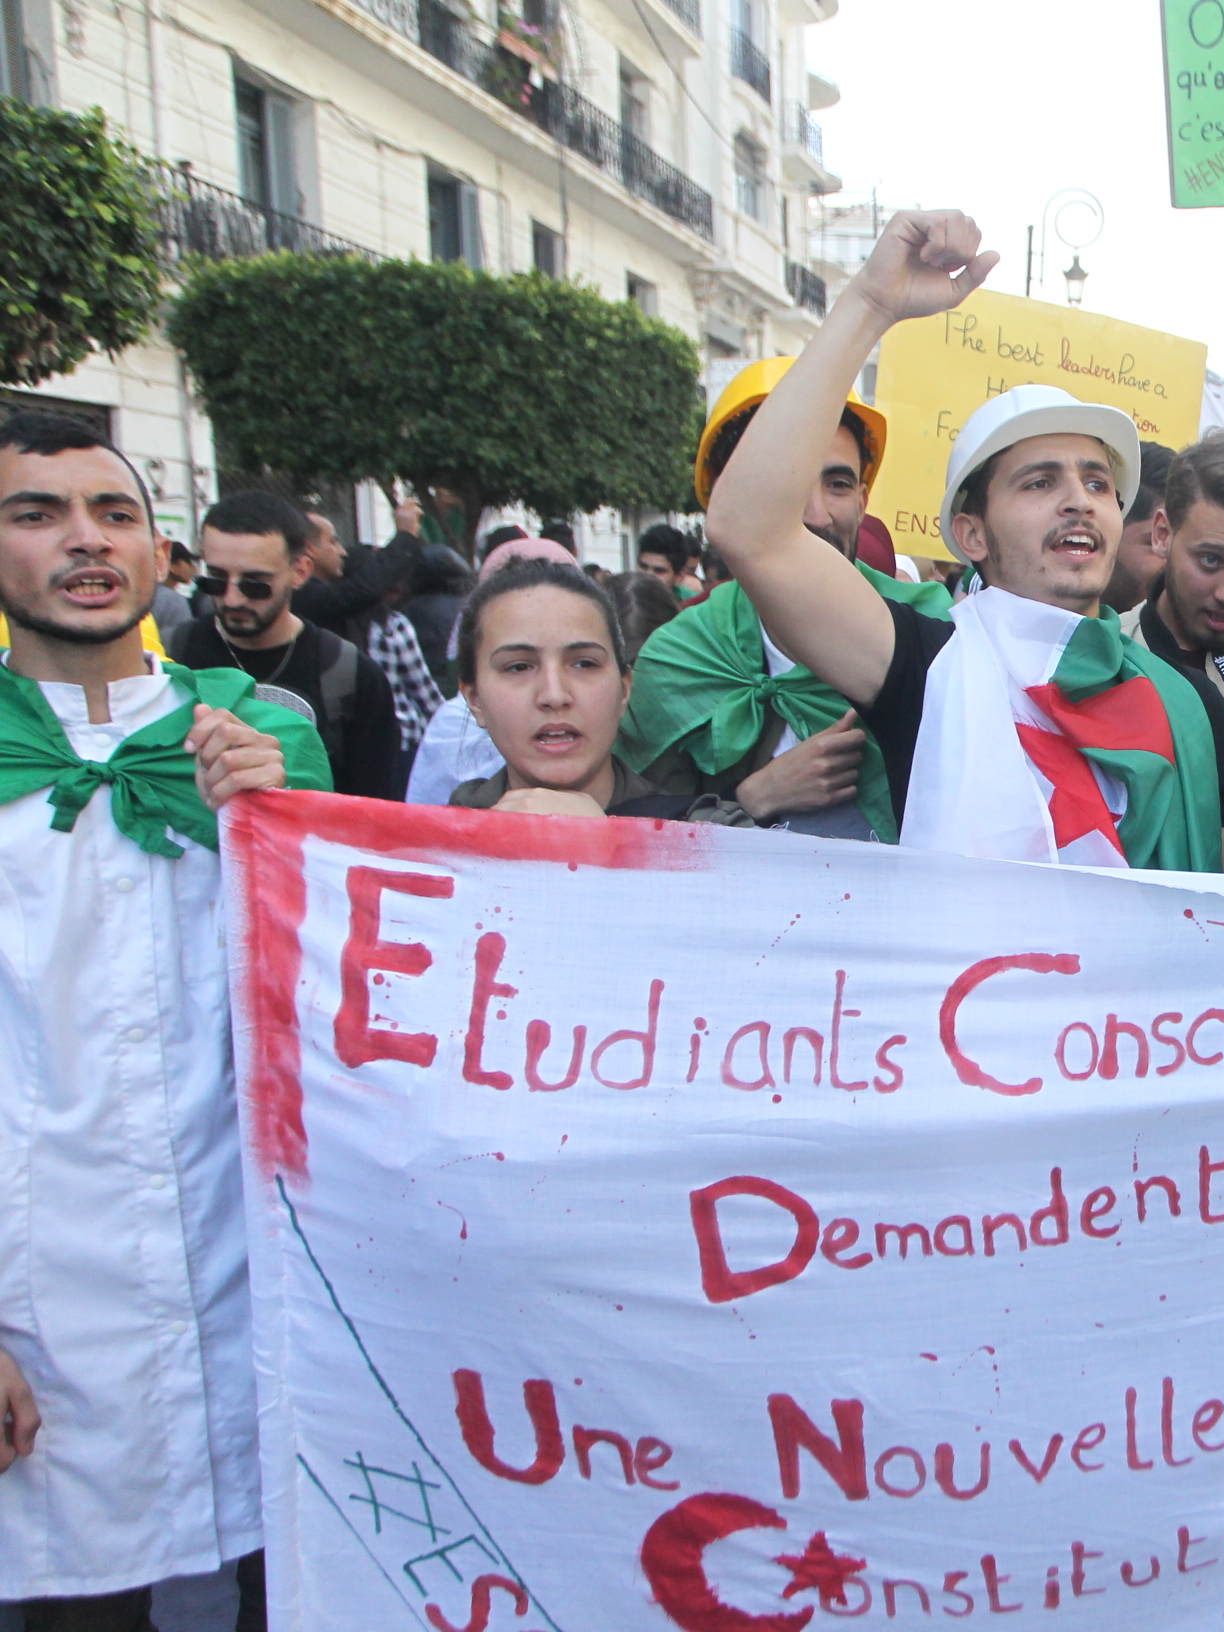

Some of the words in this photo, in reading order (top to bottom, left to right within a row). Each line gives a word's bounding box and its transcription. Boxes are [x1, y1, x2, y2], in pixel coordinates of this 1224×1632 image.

[944, 310, 986, 353] The
[997, 325, 1044, 366] best
[1058, 337, 1116, 384] leaders
[1117, 353, 1151, 392] have
[1153, 383, 1168, 398] a
[333, 865, 907, 1094] Etudiants
[451, 1366, 681, 1490] Une
